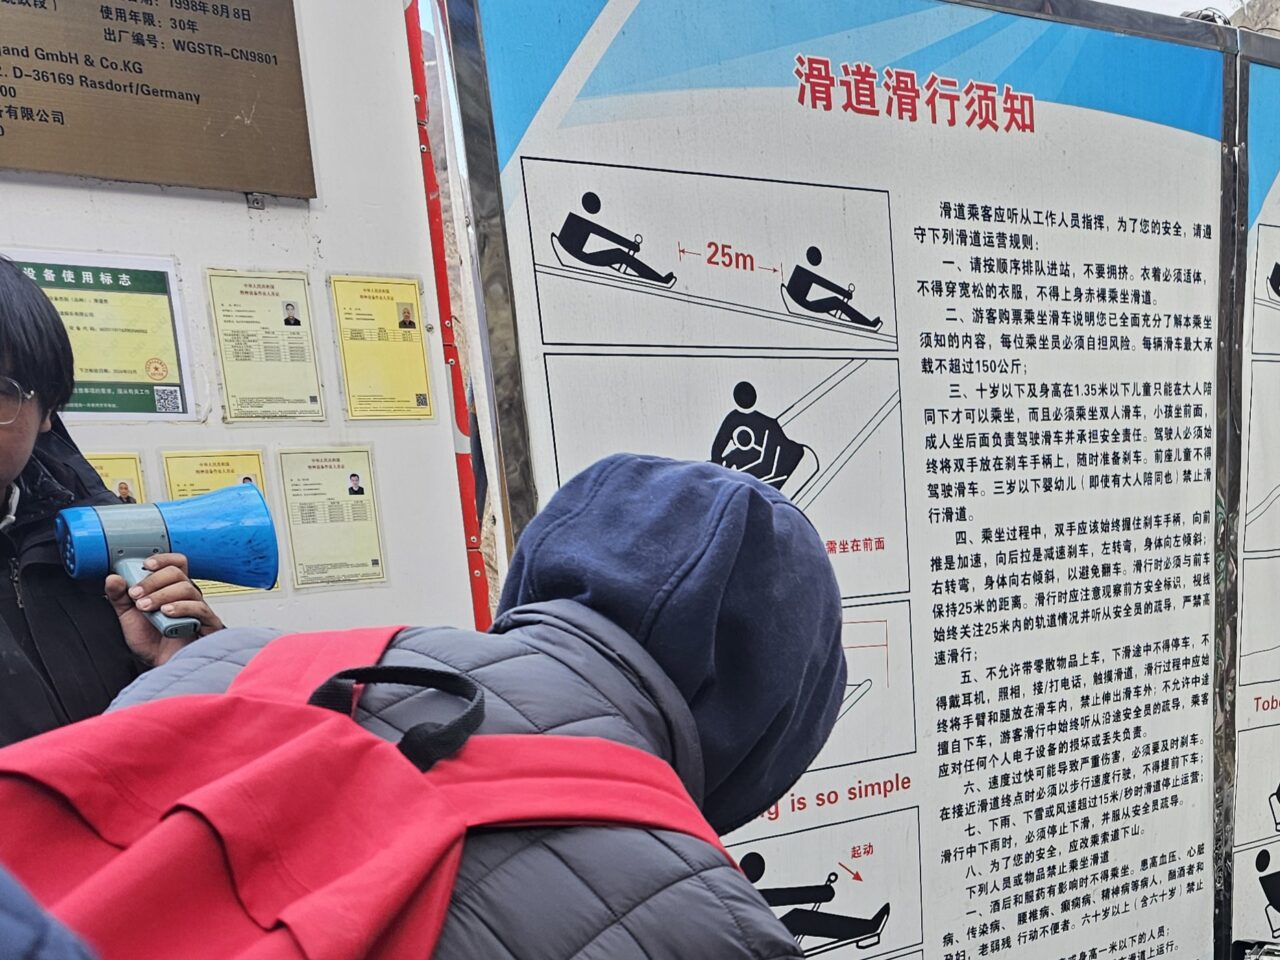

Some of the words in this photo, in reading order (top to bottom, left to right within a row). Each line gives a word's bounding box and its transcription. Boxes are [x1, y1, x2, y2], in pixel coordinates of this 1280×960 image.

[100, 5, 199, 33] 使用年限：30年
[0, 46, 29, 58] and
[35, 48, 79, 64] GmbH
[84, 55, 94, 67] &
[100, 56, 143, 74] Co.KG
[13, 66, 74, 85] D-36169
[80, 76, 201, 105] Rasdorf/Germany
[793, 54, 1036, 133] 滑道滑行须知
[0, 105, 64, 125] 有限公司
[706, 241, 756, 273] 25m
[790, 793, 806, 812] is
[816, 791, 838, 806] so
[848, 773, 911, 801] simple
[851, 844, 874, 859] 起动
